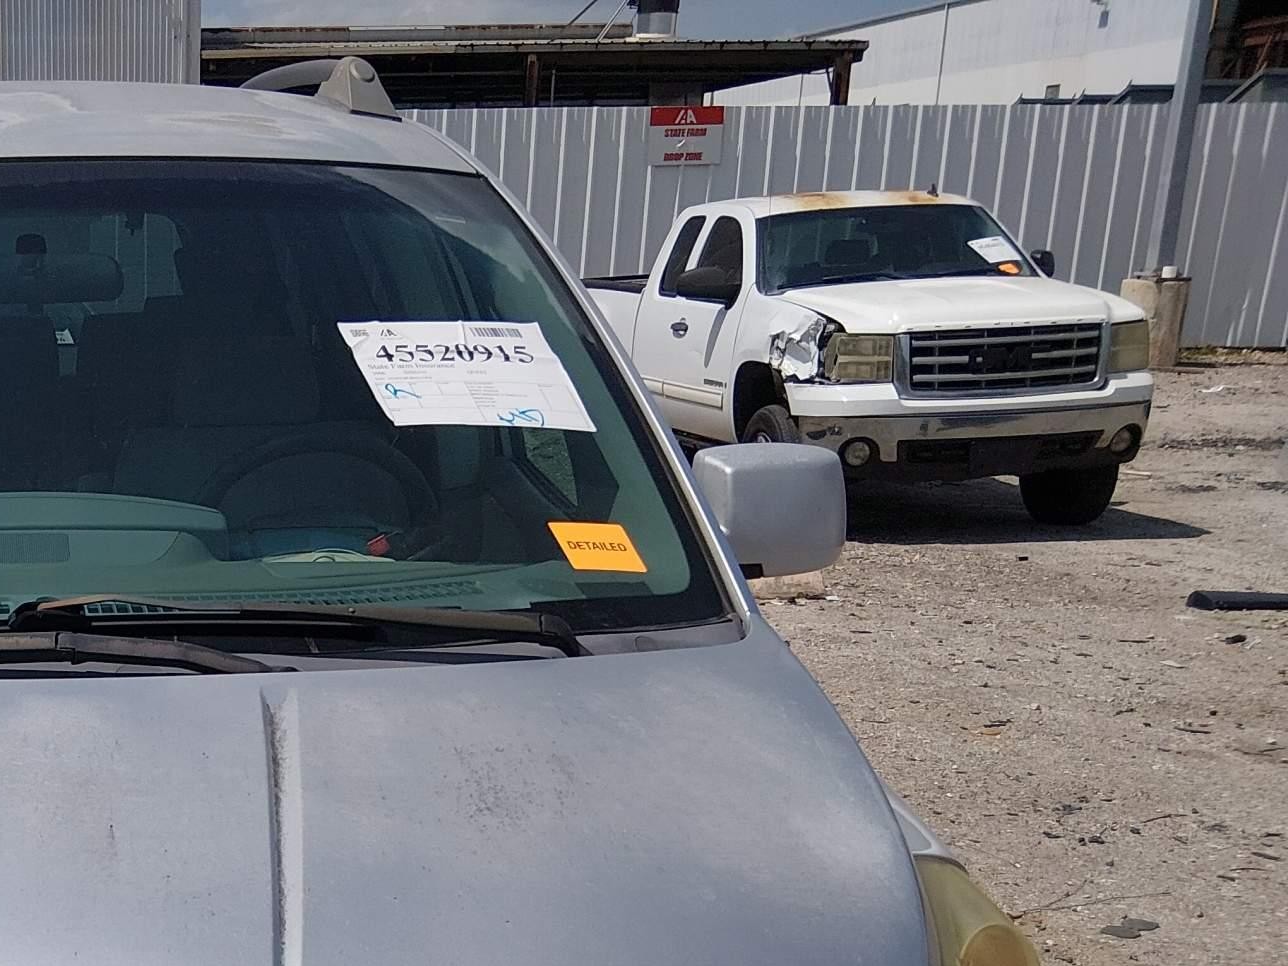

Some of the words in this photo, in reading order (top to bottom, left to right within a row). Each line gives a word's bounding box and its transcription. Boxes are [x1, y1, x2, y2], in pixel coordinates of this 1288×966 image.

[664, 128, 686, 137] STATE
[687, 127, 707, 137] FARM
[664, 152, 684, 161] DROP
[685, 152, 703, 161] ZONE
[376, 343, 534, 363] 45520915
[567, 541, 628, 552] DETAILED
